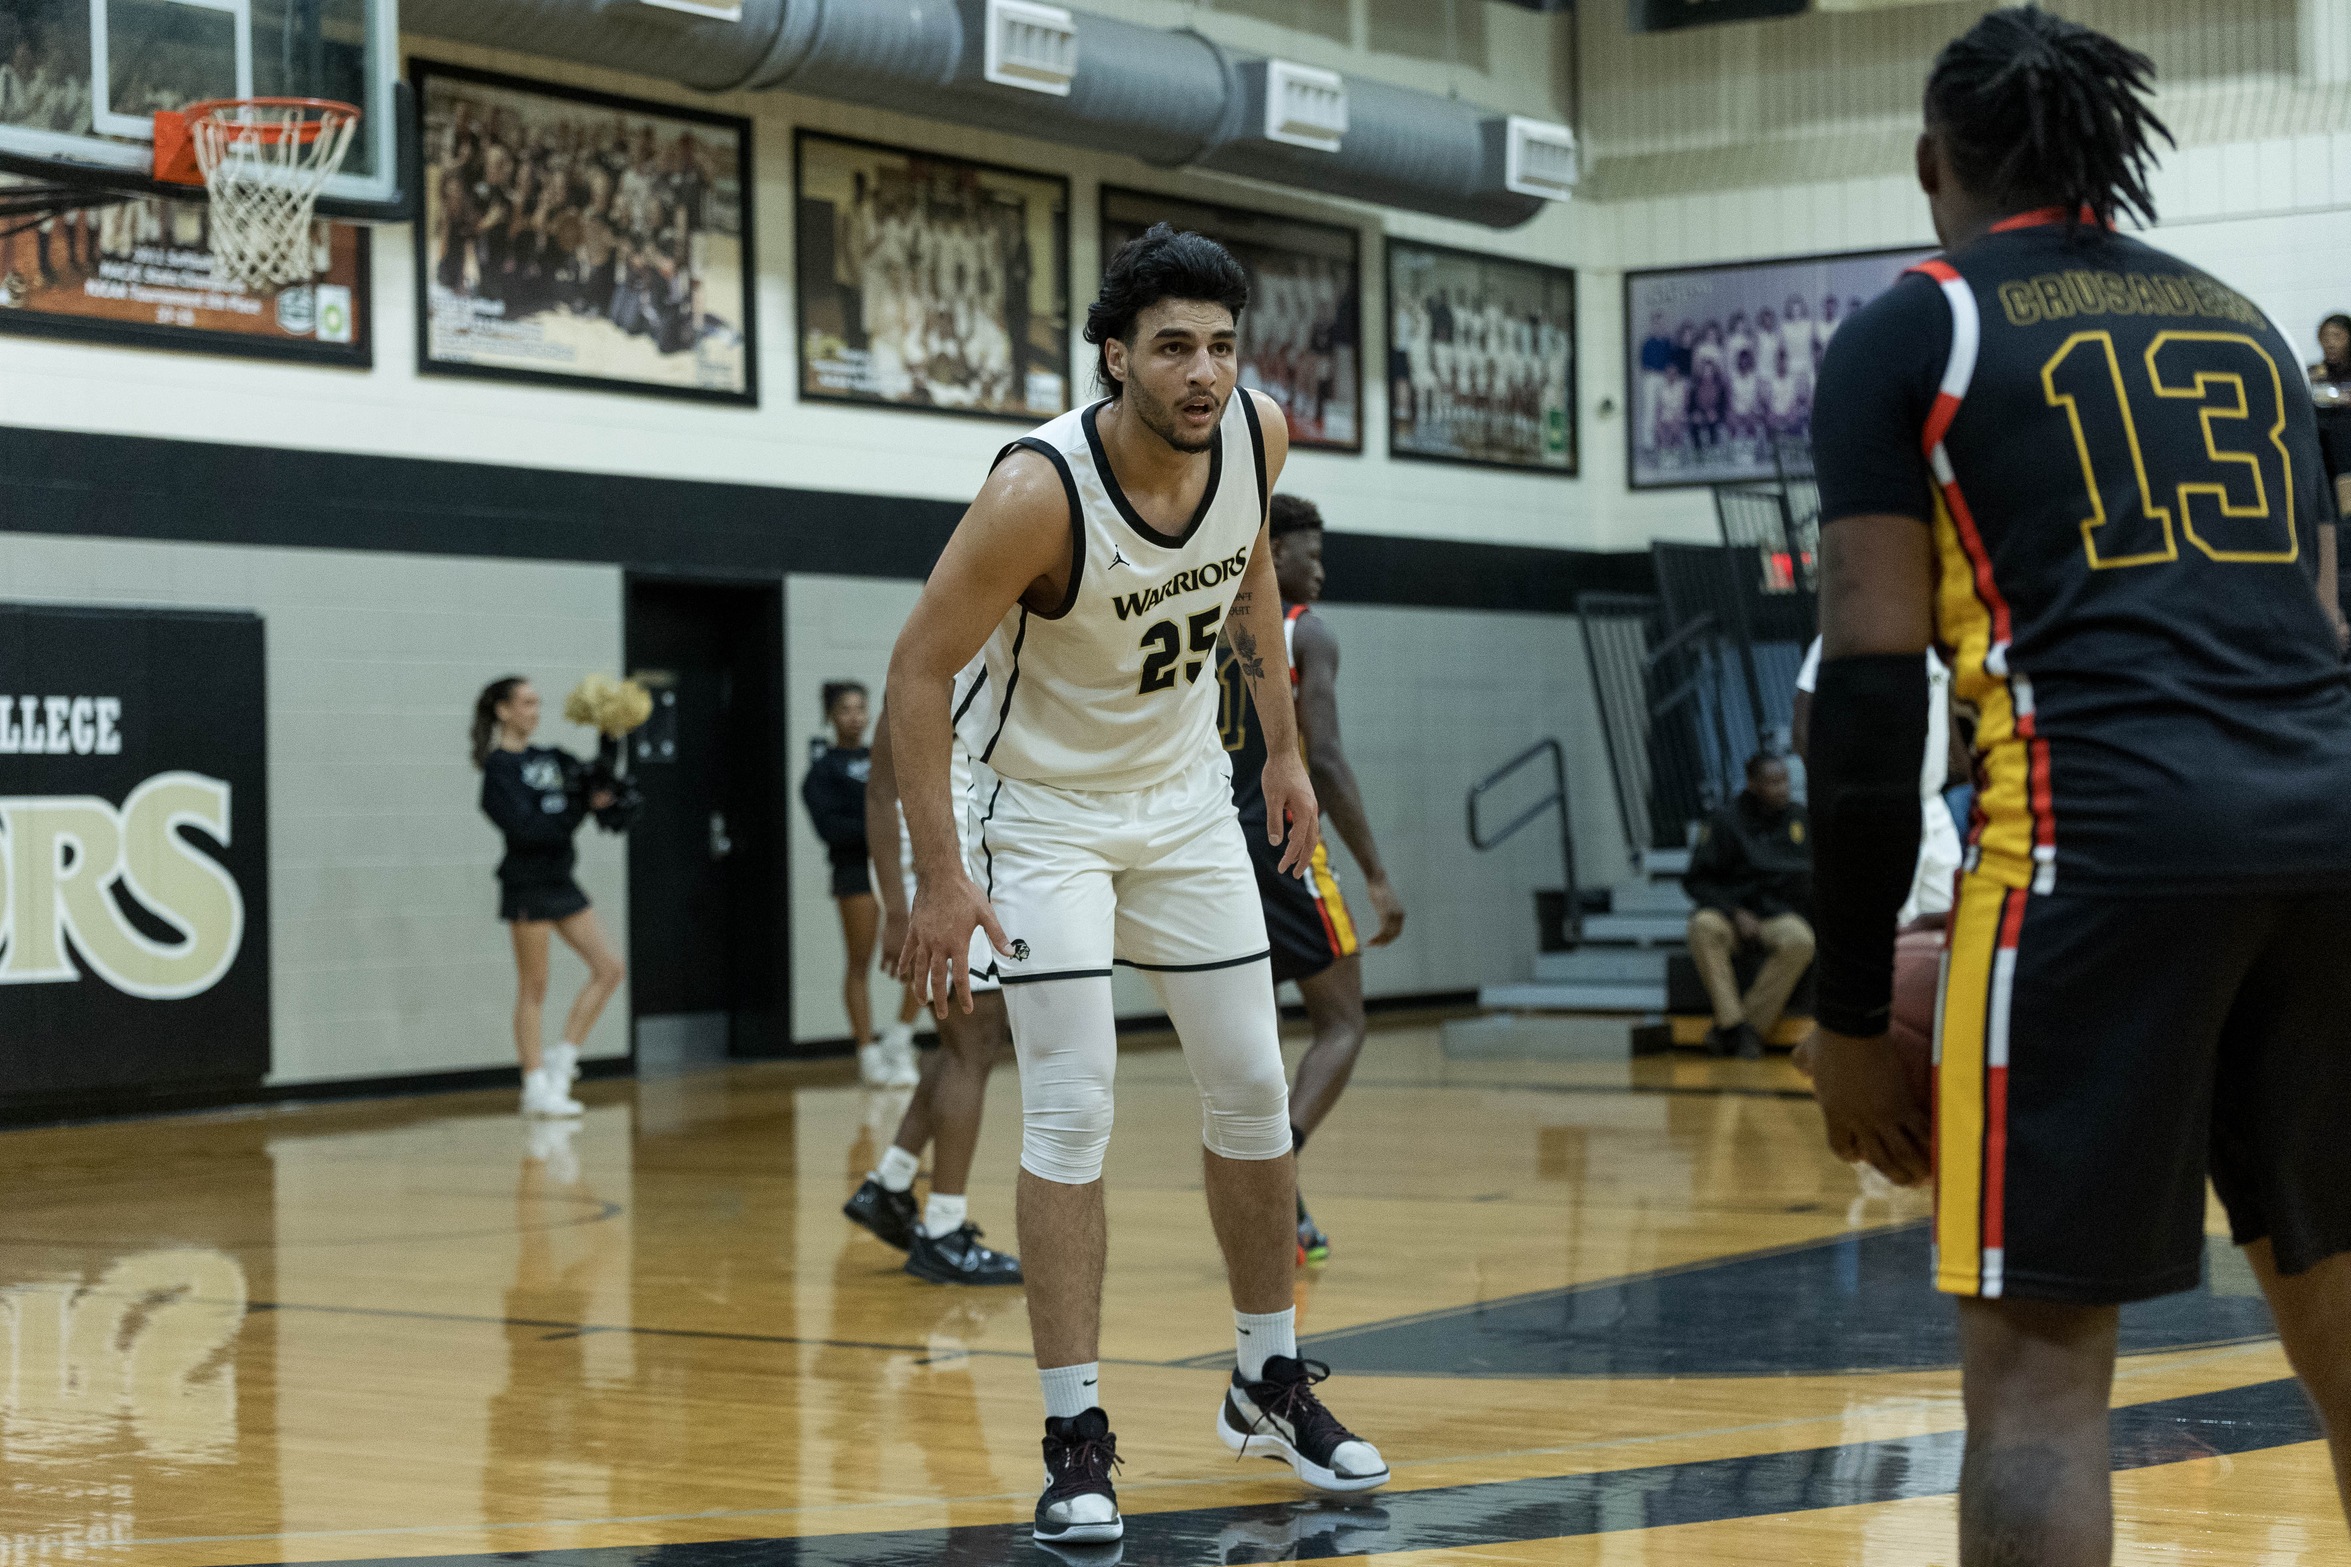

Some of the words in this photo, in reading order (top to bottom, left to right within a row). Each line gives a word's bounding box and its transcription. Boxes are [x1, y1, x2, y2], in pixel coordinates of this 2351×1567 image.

[2041, 330, 2298, 569] 13
[1111, 545, 1248, 622] WARRIORS
[1136, 600, 1223, 698] 25
[0, 769, 245, 1000] RS
